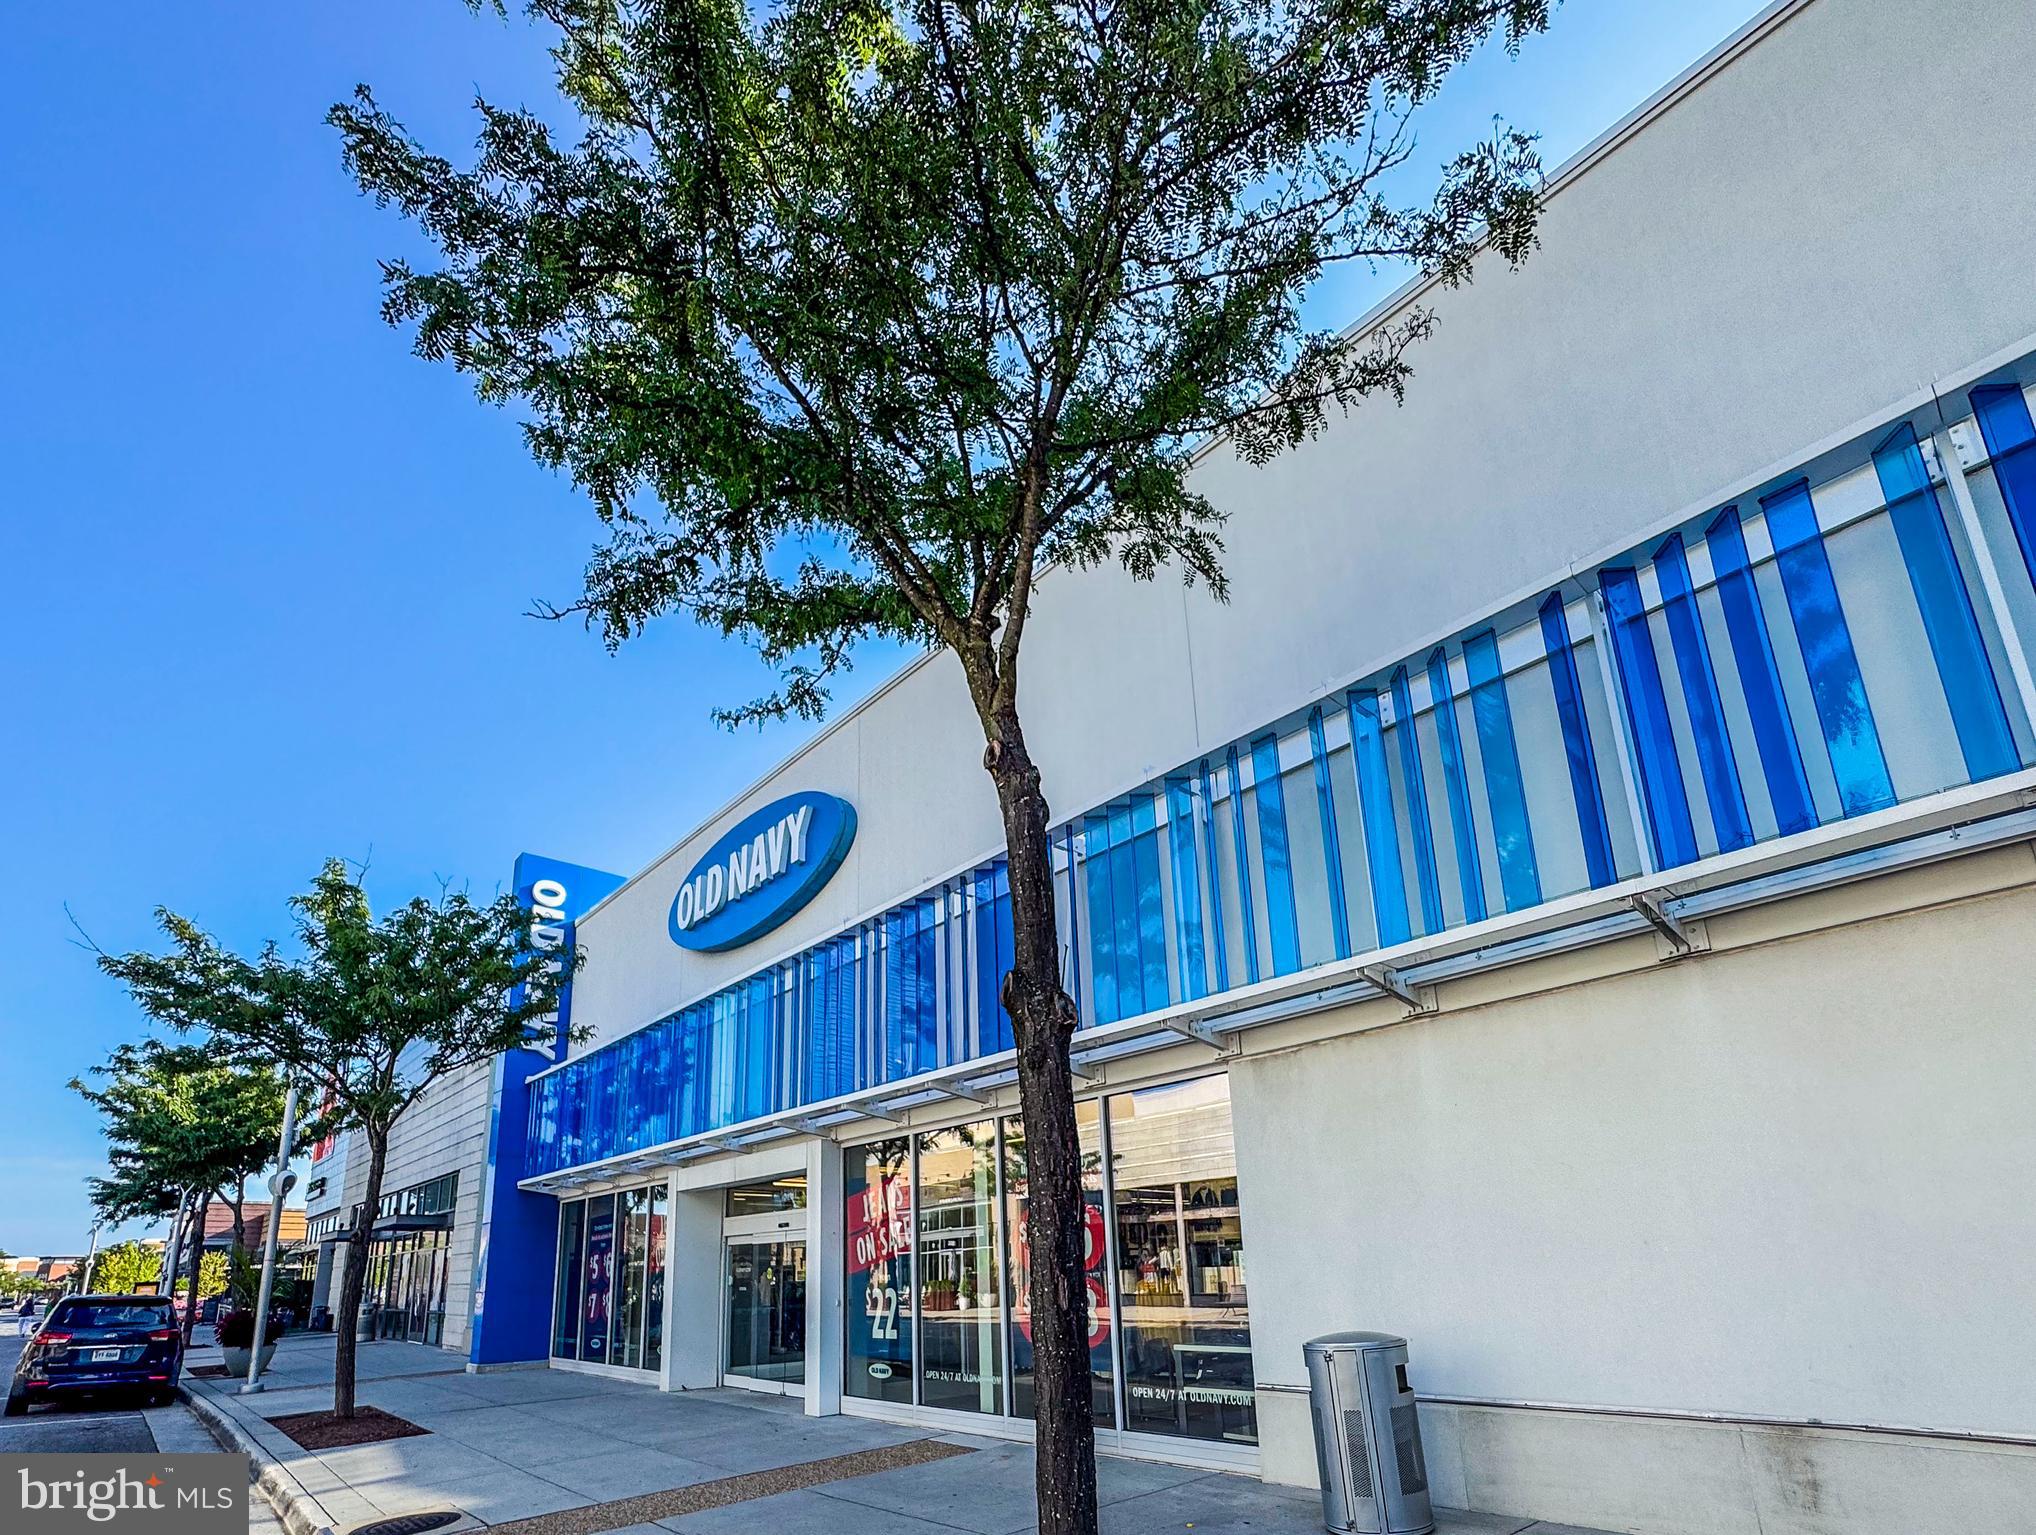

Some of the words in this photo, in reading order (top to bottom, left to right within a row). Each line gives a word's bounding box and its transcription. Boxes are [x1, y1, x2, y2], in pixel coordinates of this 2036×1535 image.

[677, 863, 727, 931] OLD
[728, 804, 814, 902] NAVY
[530, 879, 567, 950] OLD
[856, 1232, 877, 1264] ON
[866, 1286, 897, 1339] $22
[926, 1370, 939, 1380] OPEN
[941, 1371, 954, 1382] 24/7
[955, 1373, 961, 1382] AT
[1132, 1387, 1153, 1399] OPEN
[1155, 1388, 1175, 1402] 24/7
[1178, 1390, 1187, 1401] AT
[1190, 1392, 1252, 1406] OLDNAVY.COM
